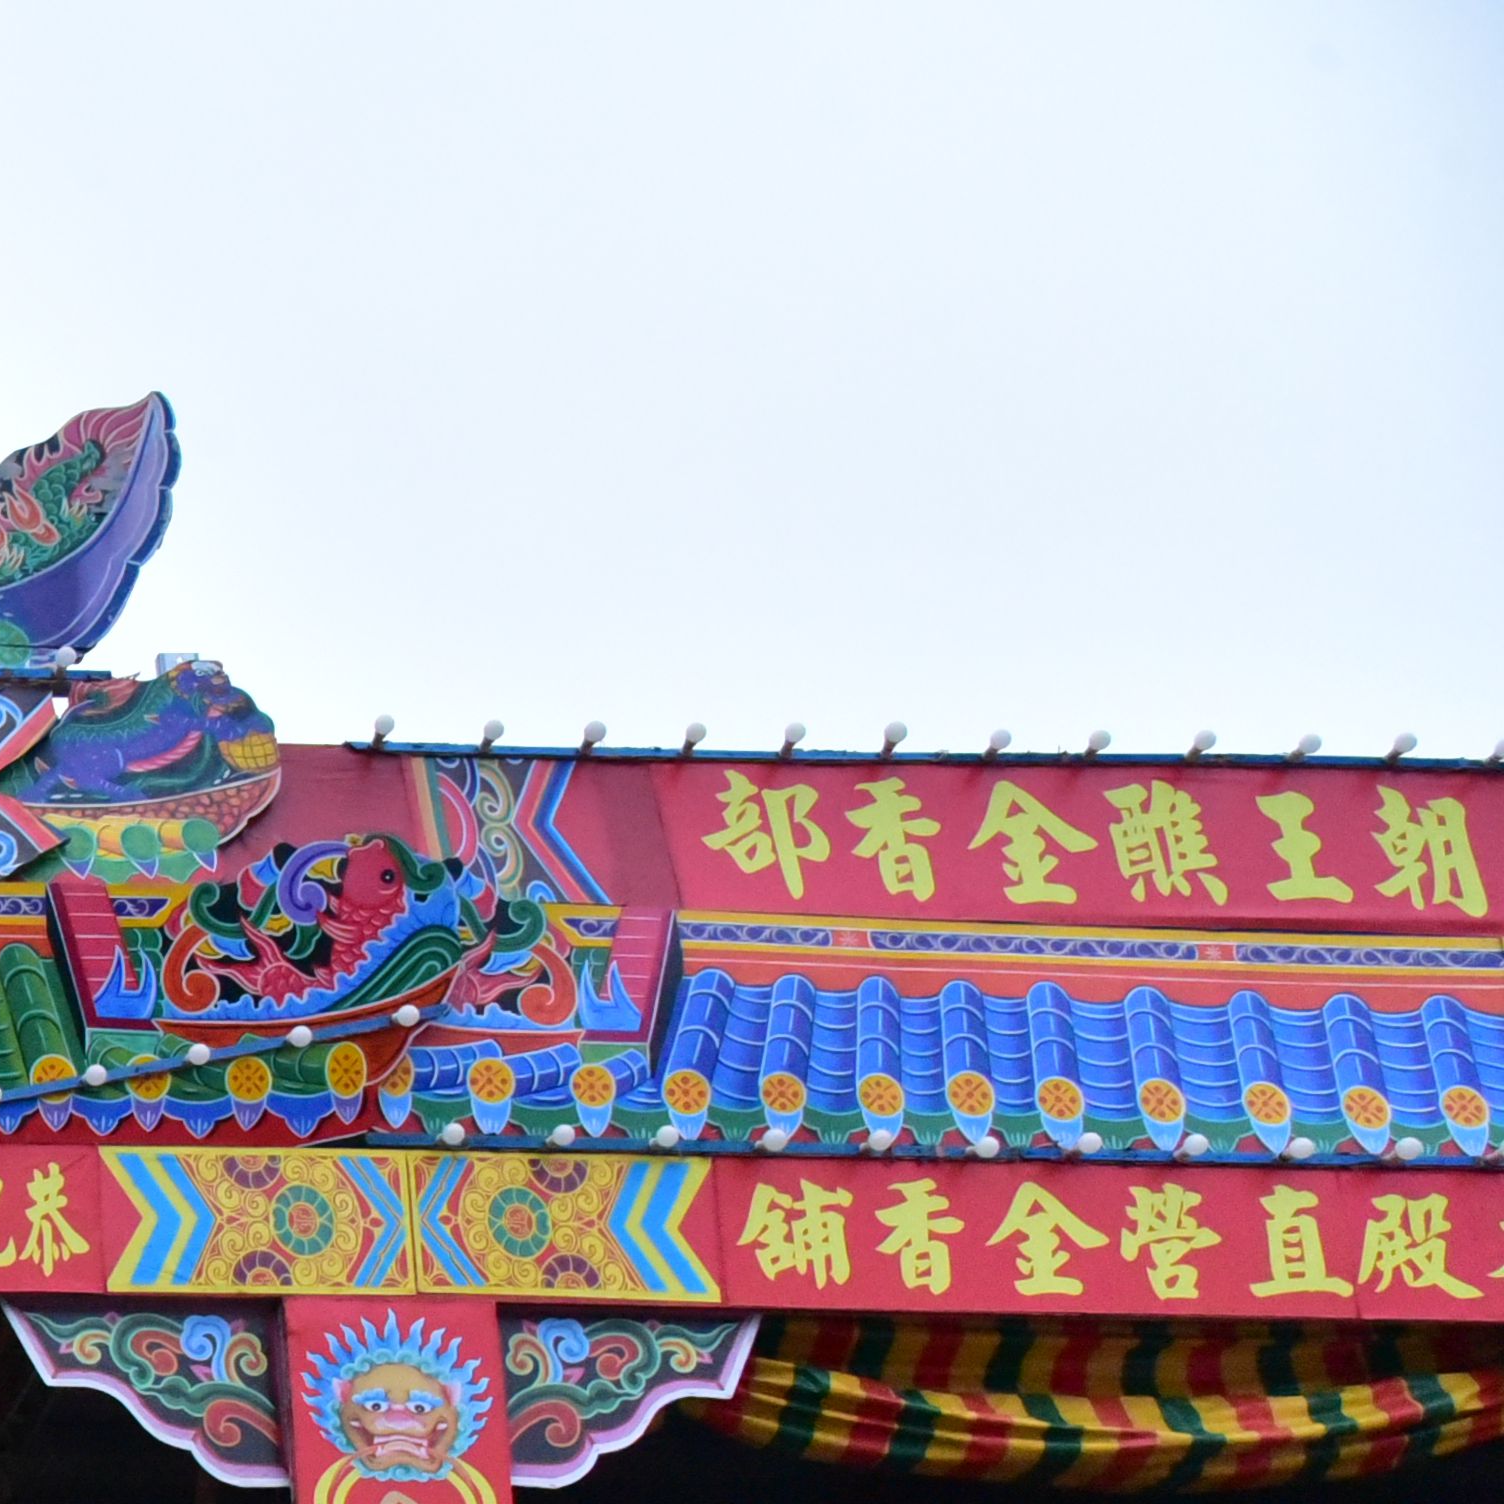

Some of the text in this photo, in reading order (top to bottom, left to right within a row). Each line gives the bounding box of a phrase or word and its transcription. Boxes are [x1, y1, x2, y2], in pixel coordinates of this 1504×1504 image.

[736, 1177, 1504, 1300] 殿直營金香舖
